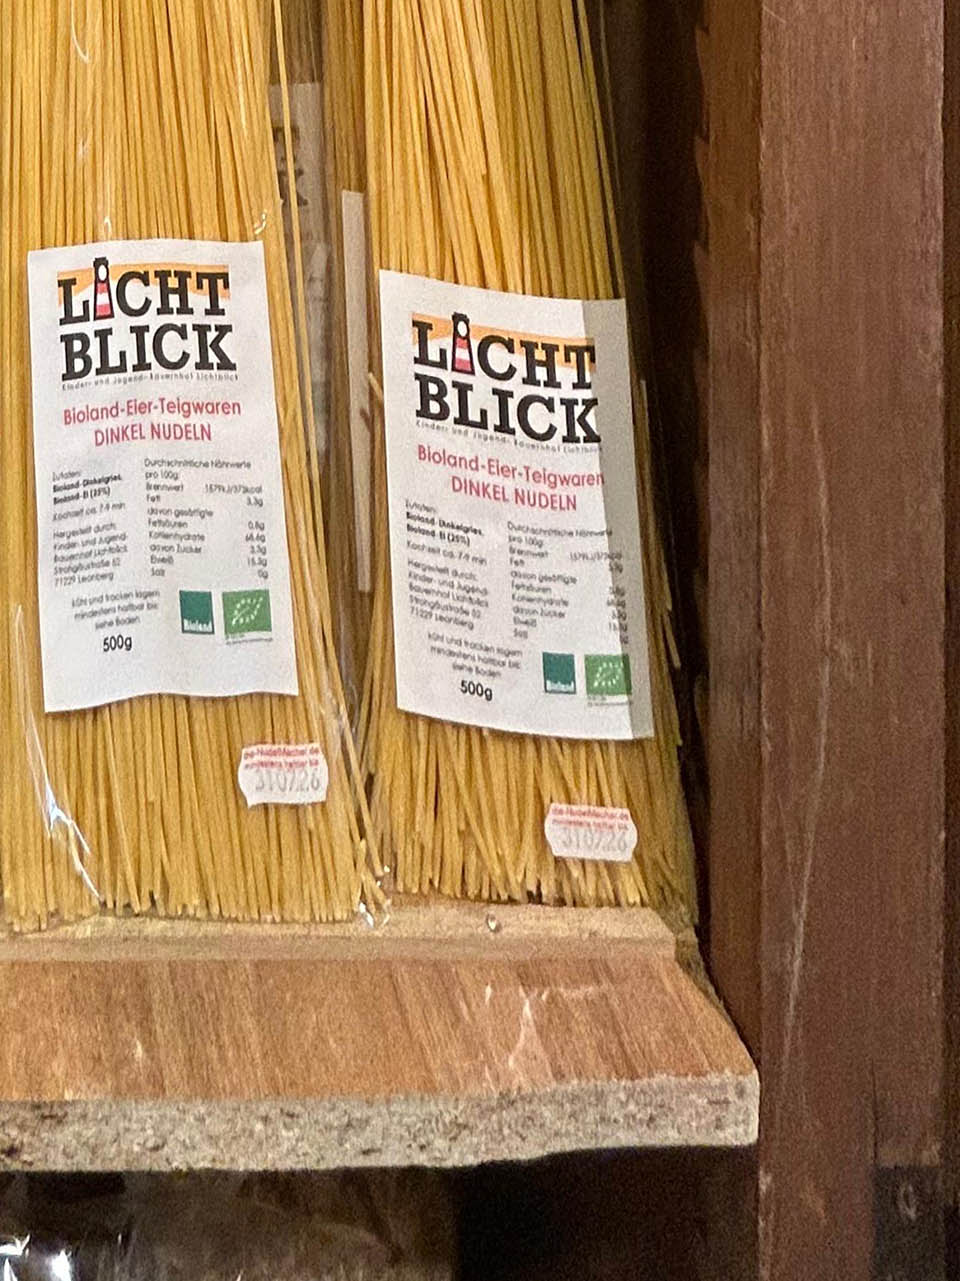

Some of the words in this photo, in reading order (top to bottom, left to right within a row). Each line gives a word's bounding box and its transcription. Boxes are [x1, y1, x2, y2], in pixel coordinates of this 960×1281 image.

[59, 323, 237, 382] BLICK
[63, 397, 241, 426] Bioland-Eier-Teigwaren
[413, 372, 602, 444] BLICK
[95, 424, 146, 447] DINKEL
[151, 423, 212, 441] NUDELN
[417, 444, 605, 489] Bioland-Eier-Teigwaren
[451, 475, 509, 503] DINKEL
[514, 488, 577, 511] NUDELN
[103, 634, 132, 652] 500g
[460, 680, 493, 702] 500g
